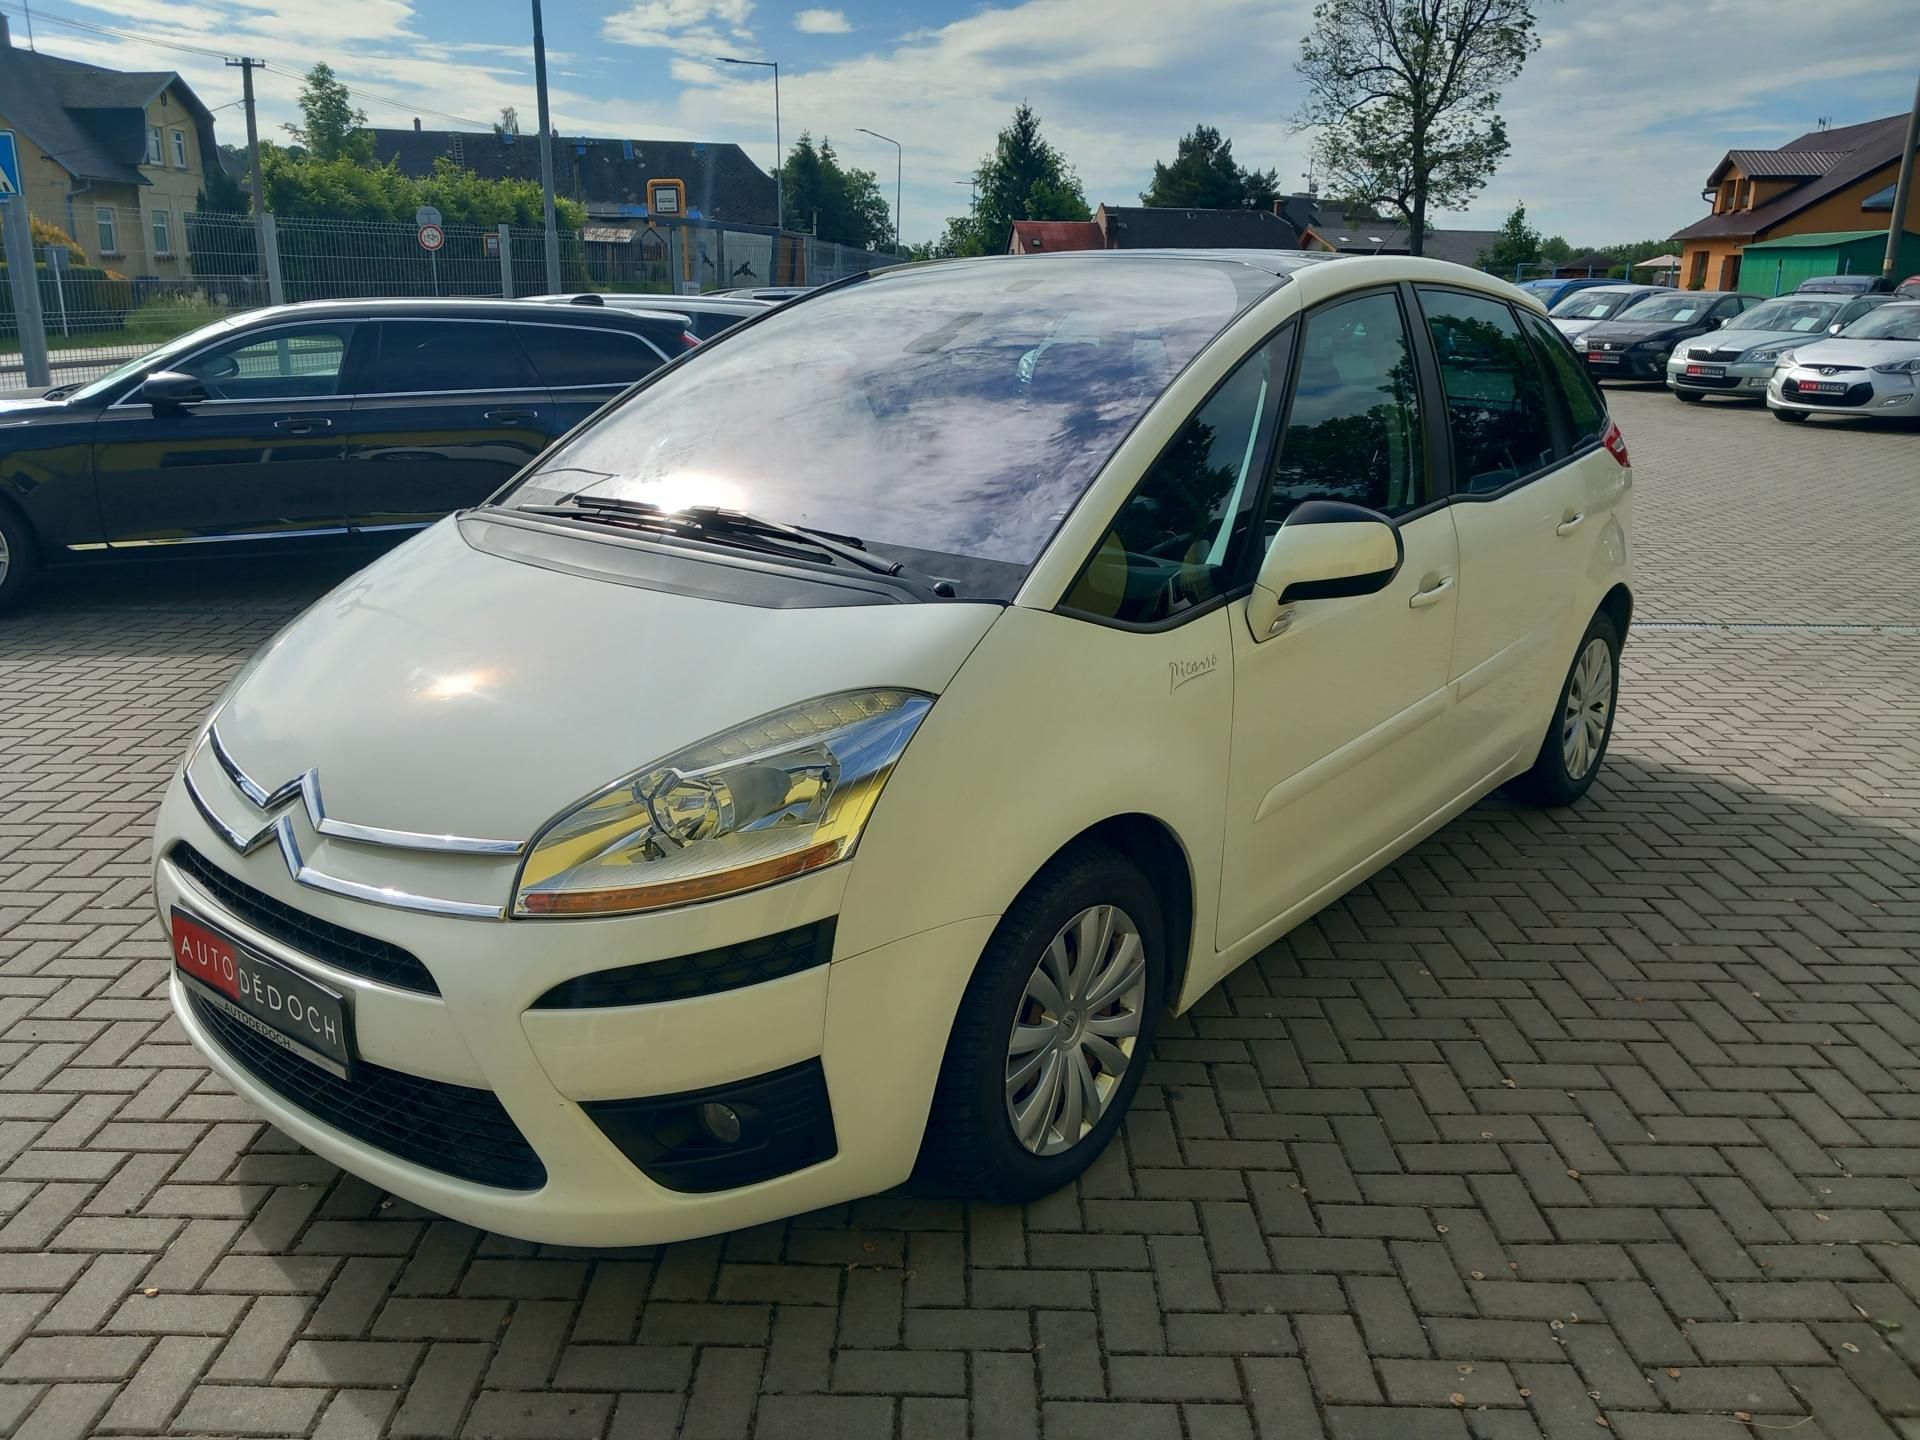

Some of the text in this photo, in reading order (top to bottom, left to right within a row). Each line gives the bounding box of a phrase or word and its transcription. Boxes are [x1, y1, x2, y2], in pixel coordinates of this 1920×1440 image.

[181, 935, 337, 1045] AUTO DĚDOCH
[223, 1002, 291, 1049] AUTODEDOCH
